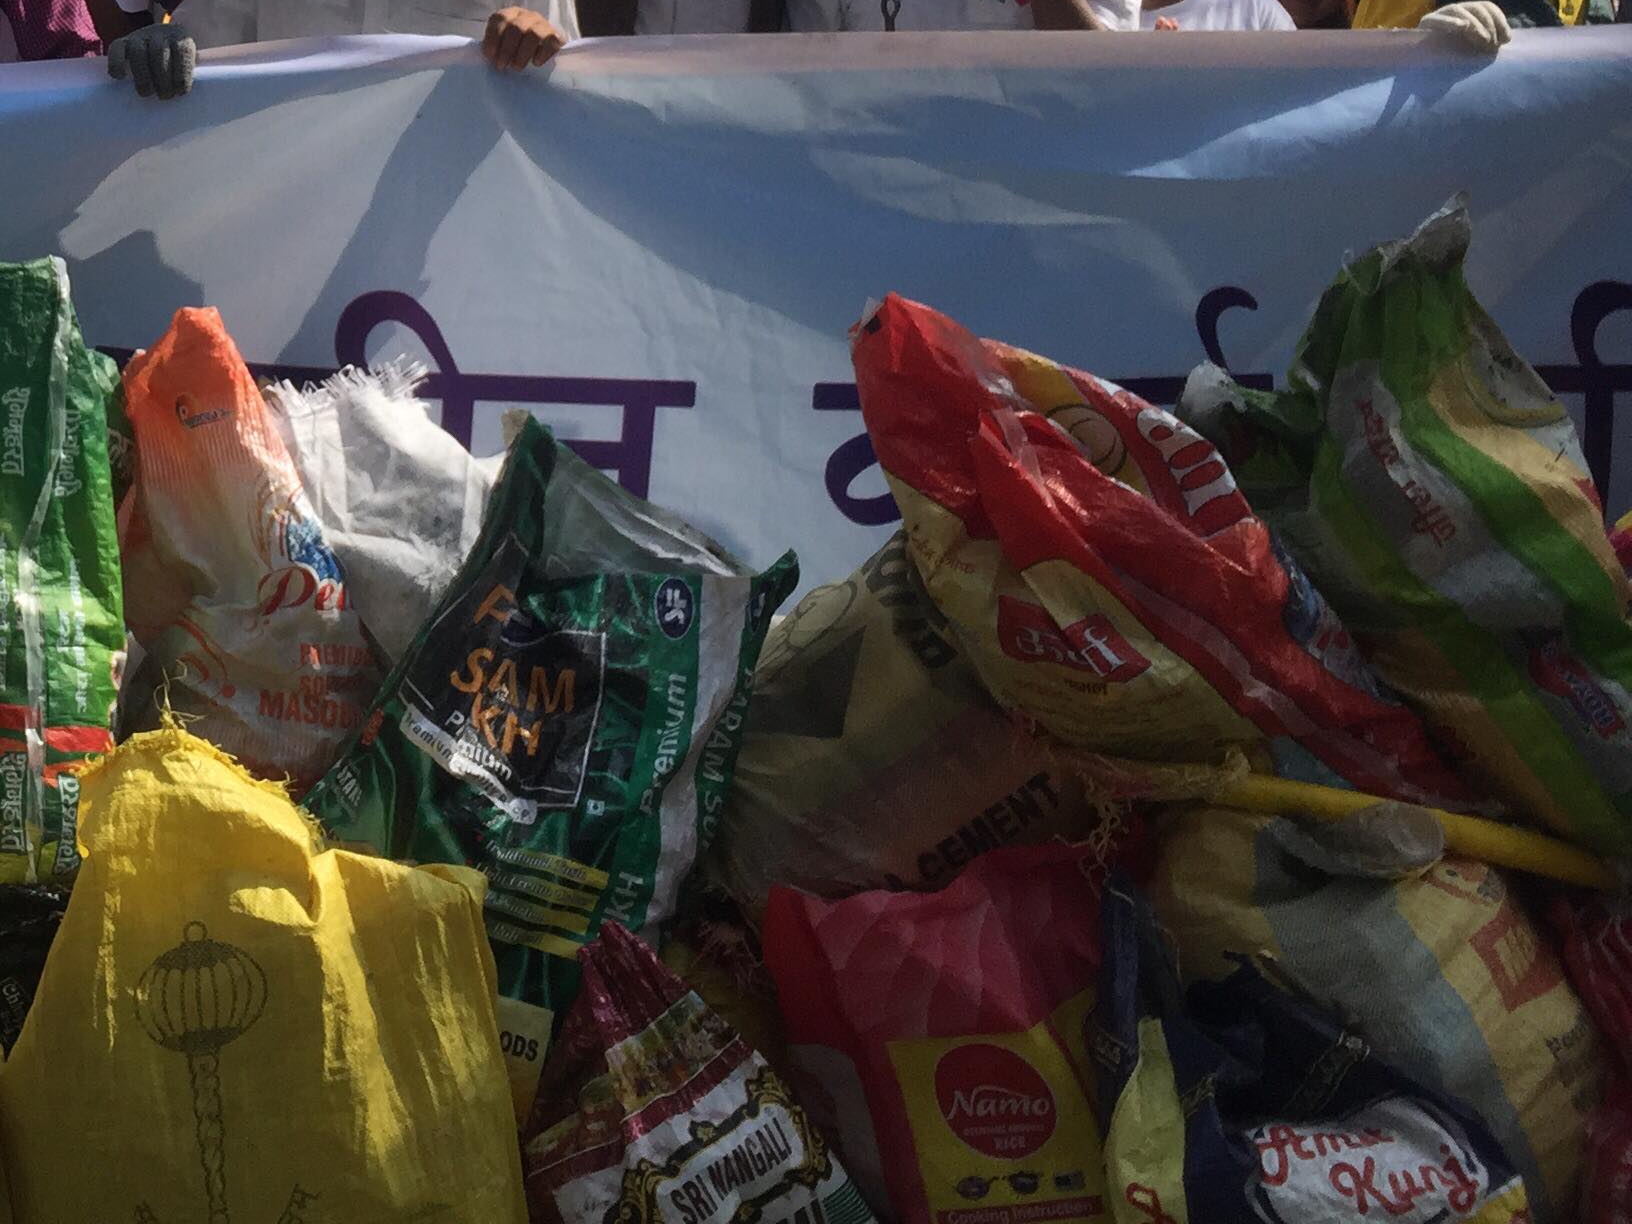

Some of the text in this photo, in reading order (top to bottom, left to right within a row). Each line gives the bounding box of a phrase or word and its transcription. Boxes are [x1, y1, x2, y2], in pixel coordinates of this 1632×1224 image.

[917, 772, 1058, 882] CEMENT
[946, 1085, 1051, 1121] Namo
[992, 1135, 1026, 1151] RICE
[670, 1174, 718, 1224] SRI
[1329, 1143, 1479, 1215] Kunj
